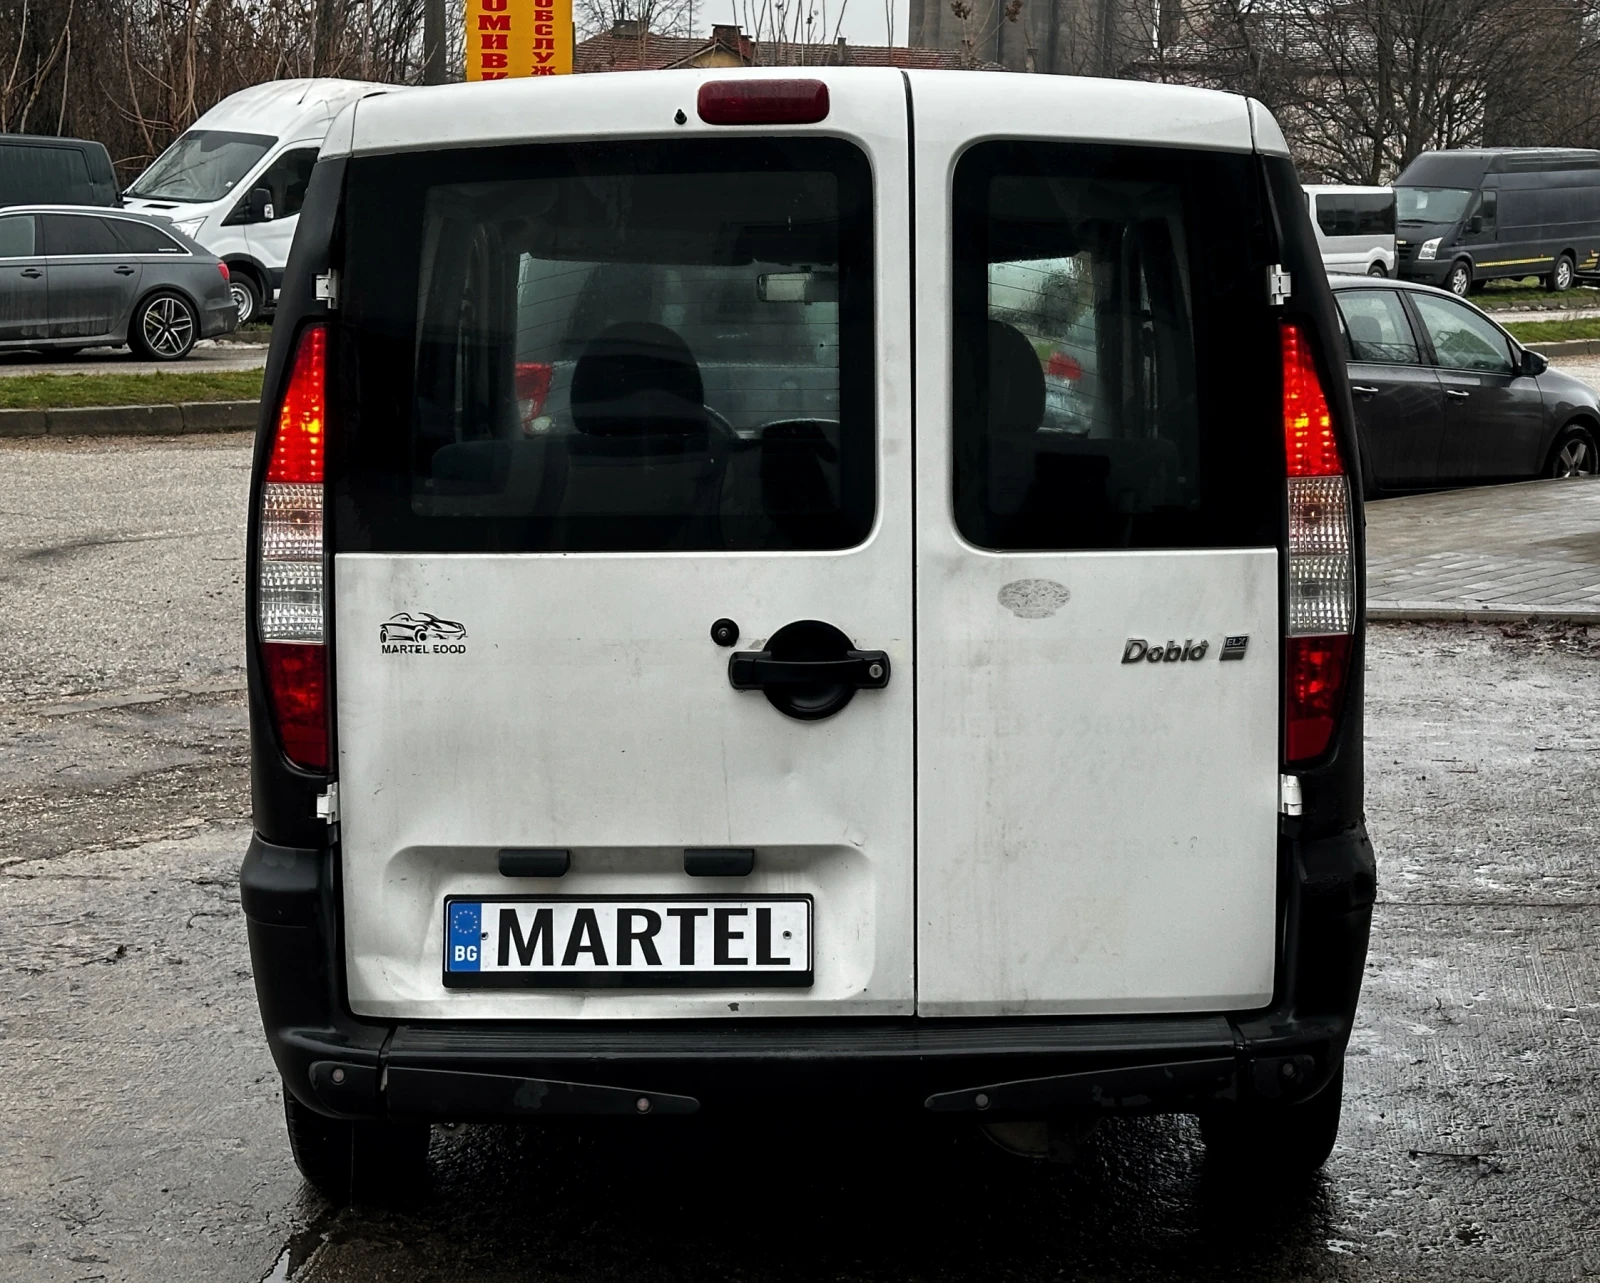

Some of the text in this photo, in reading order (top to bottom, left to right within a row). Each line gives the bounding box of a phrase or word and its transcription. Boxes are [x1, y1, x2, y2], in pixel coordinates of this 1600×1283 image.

[1226, 637, 1247, 646] ELX
[381, 644, 467, 654] MARTEL EOOD
[497, 908, 791, 966] MARTEL
[454, 945, 478, 962] BG
